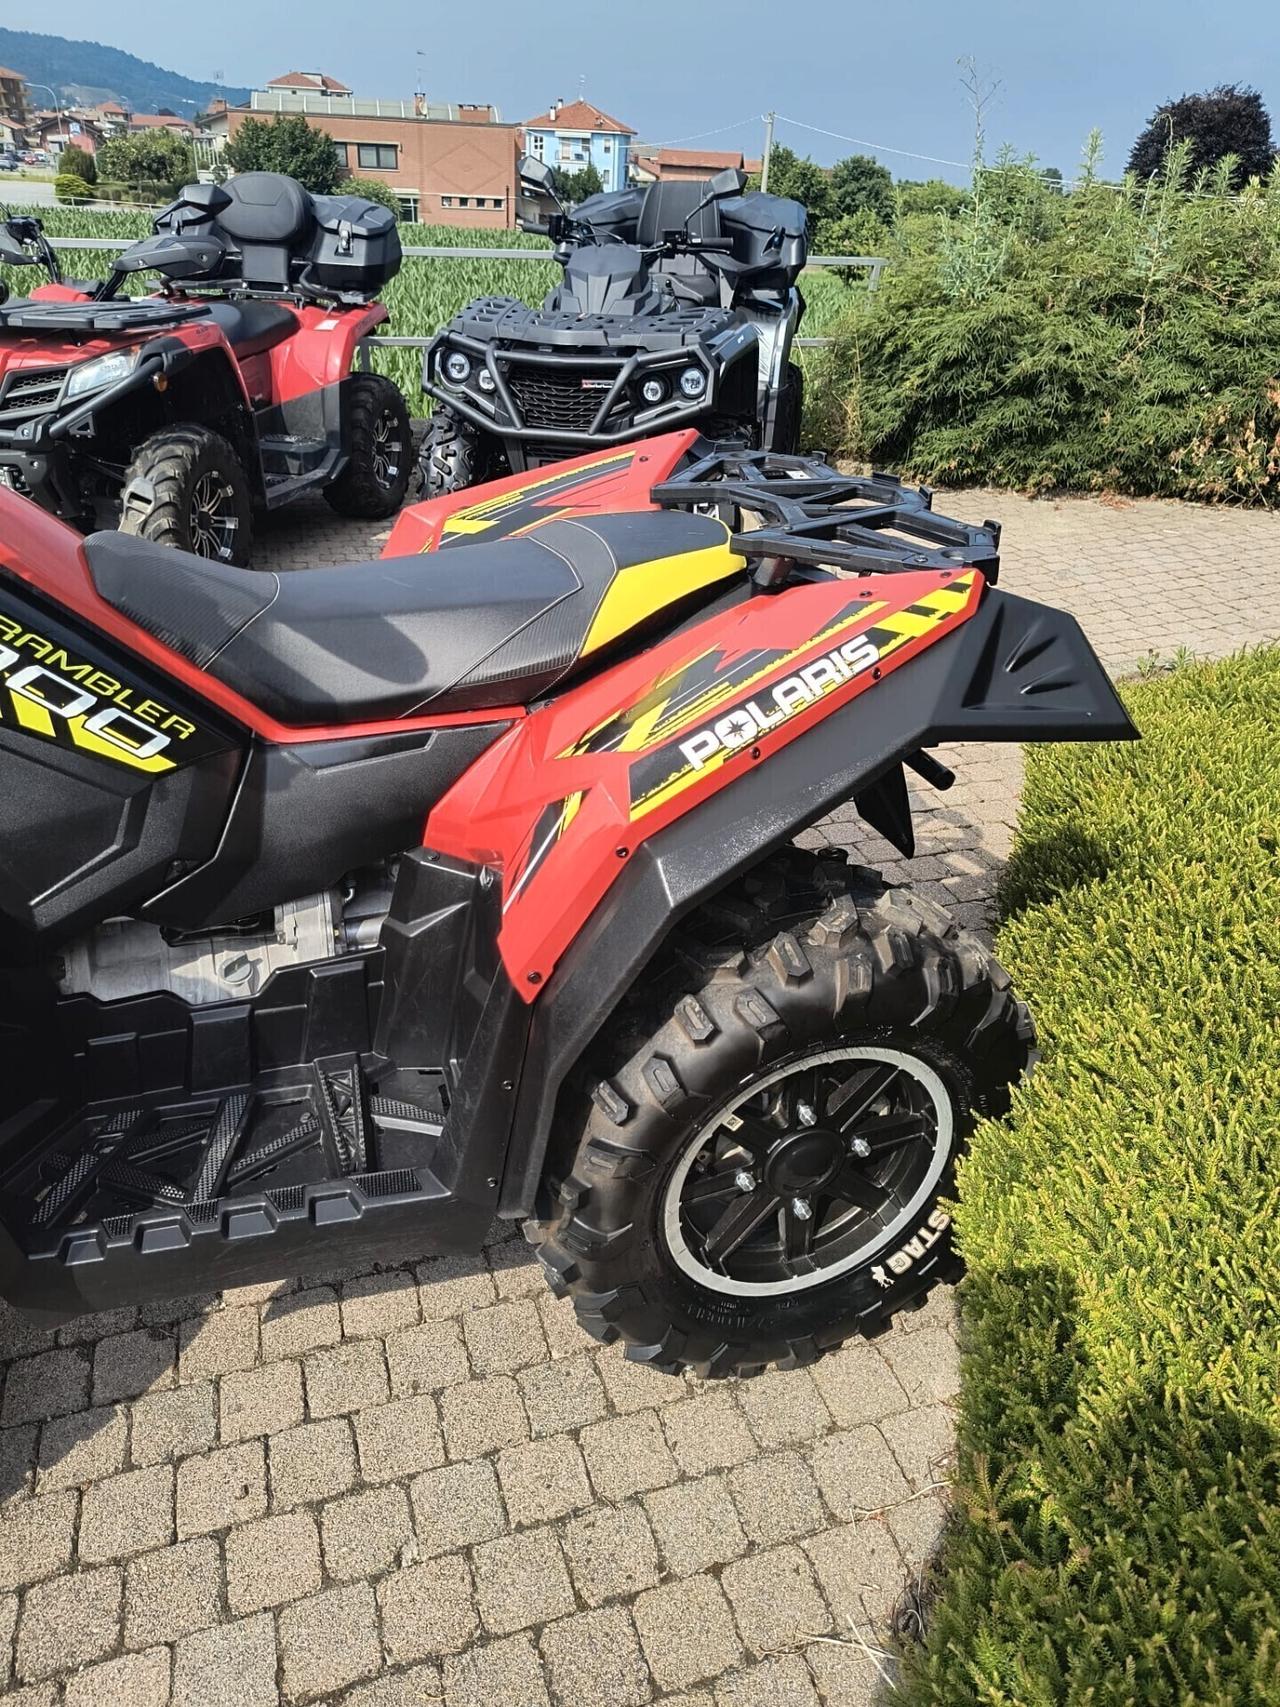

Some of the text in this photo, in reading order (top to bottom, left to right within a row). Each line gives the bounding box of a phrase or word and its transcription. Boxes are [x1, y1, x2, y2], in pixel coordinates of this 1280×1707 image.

[0, 643, 171, 759] 00
[679, 634, 881, 772] POLARIS
[885, 1208, 951, 1275] STAG
